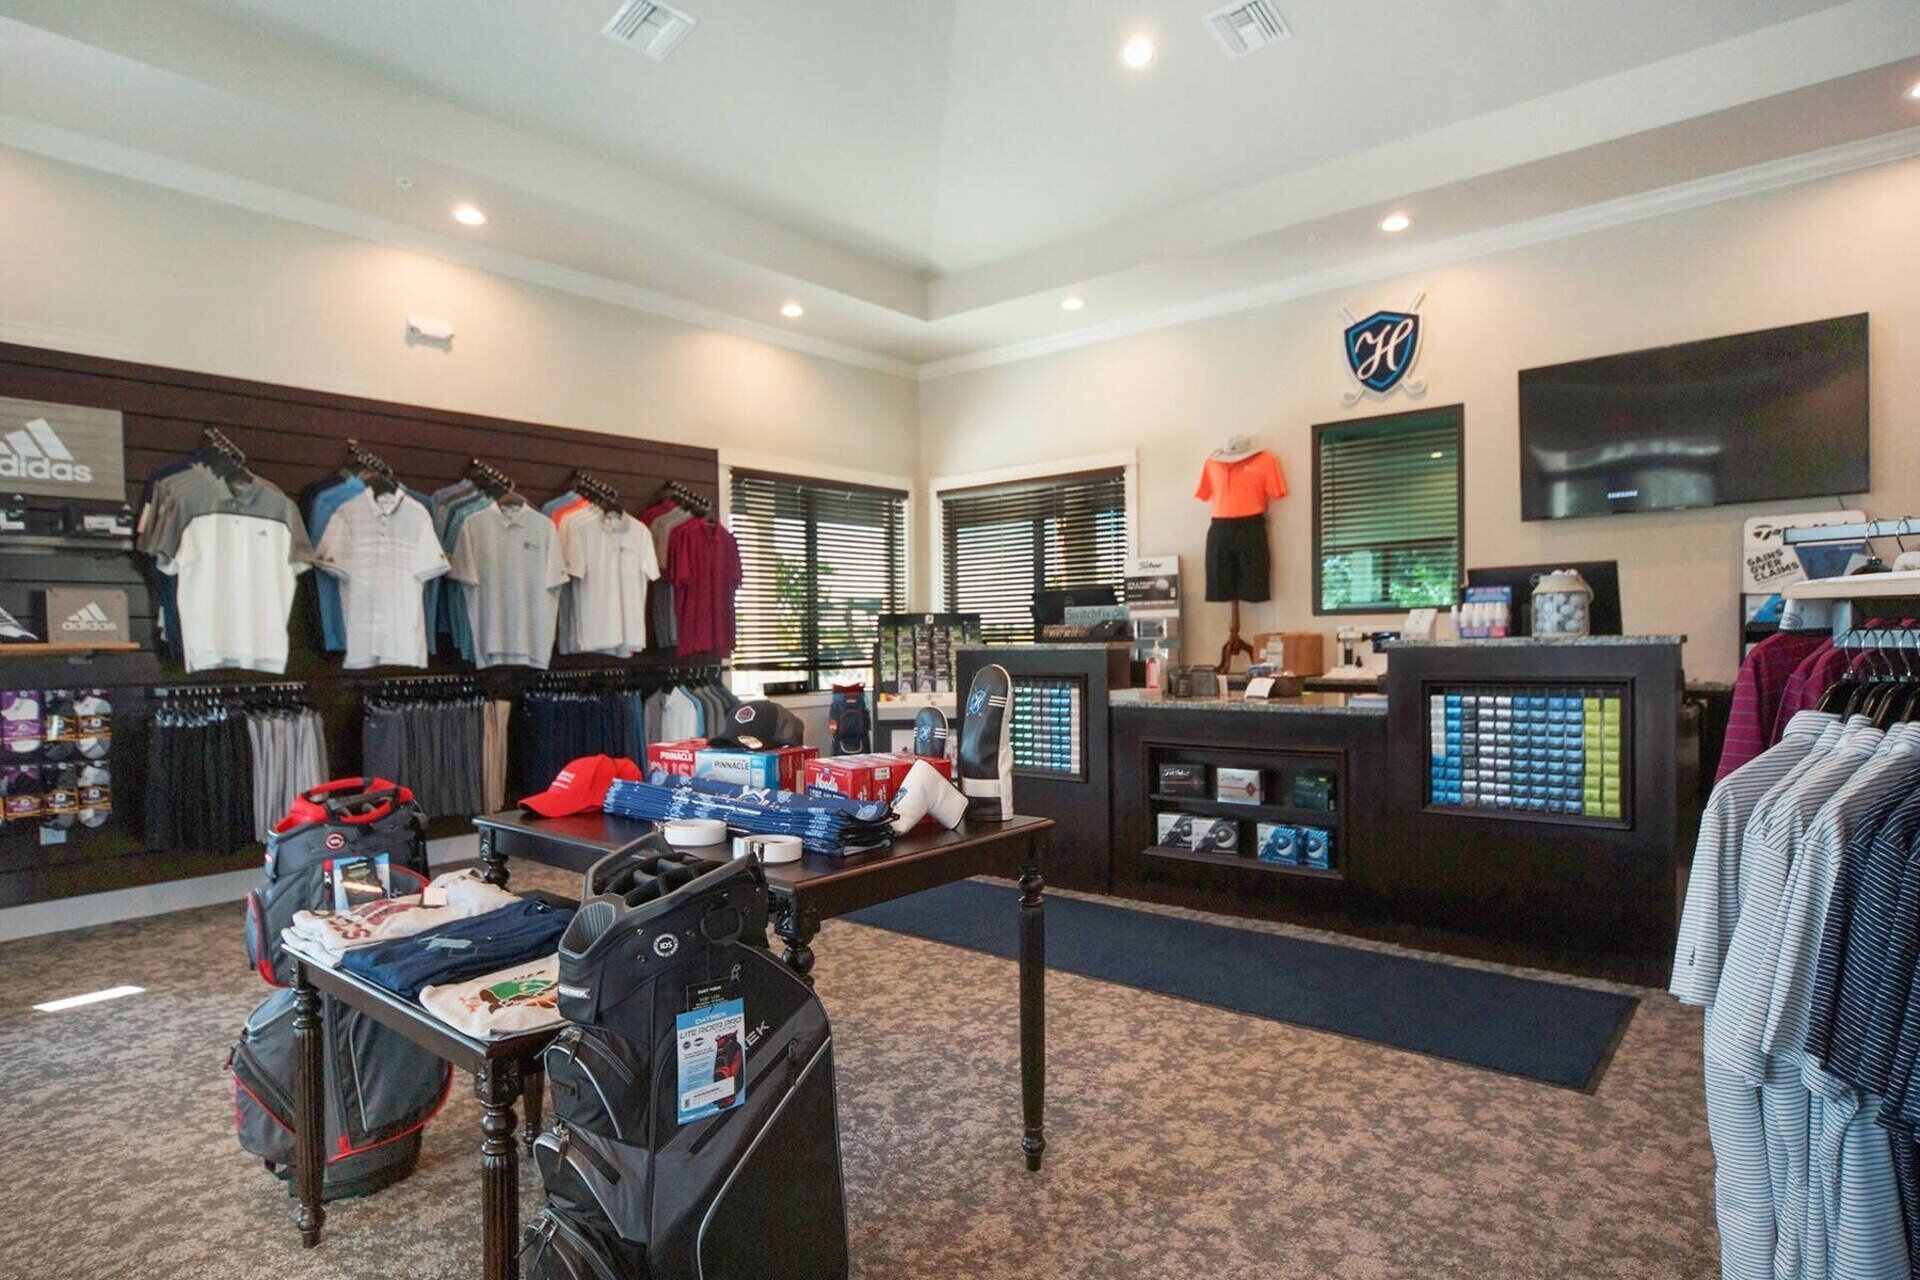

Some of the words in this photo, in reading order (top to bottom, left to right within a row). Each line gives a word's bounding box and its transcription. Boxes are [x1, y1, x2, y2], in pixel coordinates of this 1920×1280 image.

[0, 453, 93, 483] didas
[1746, 549, 1784, 567] GAINS
[1750, 559, 1780, 575] OVER
[1753, 561, 1800, 582] CLAIMS
[62, 619, 117, 632] adidas
[714, 759, 751, 771] PINNACLE
